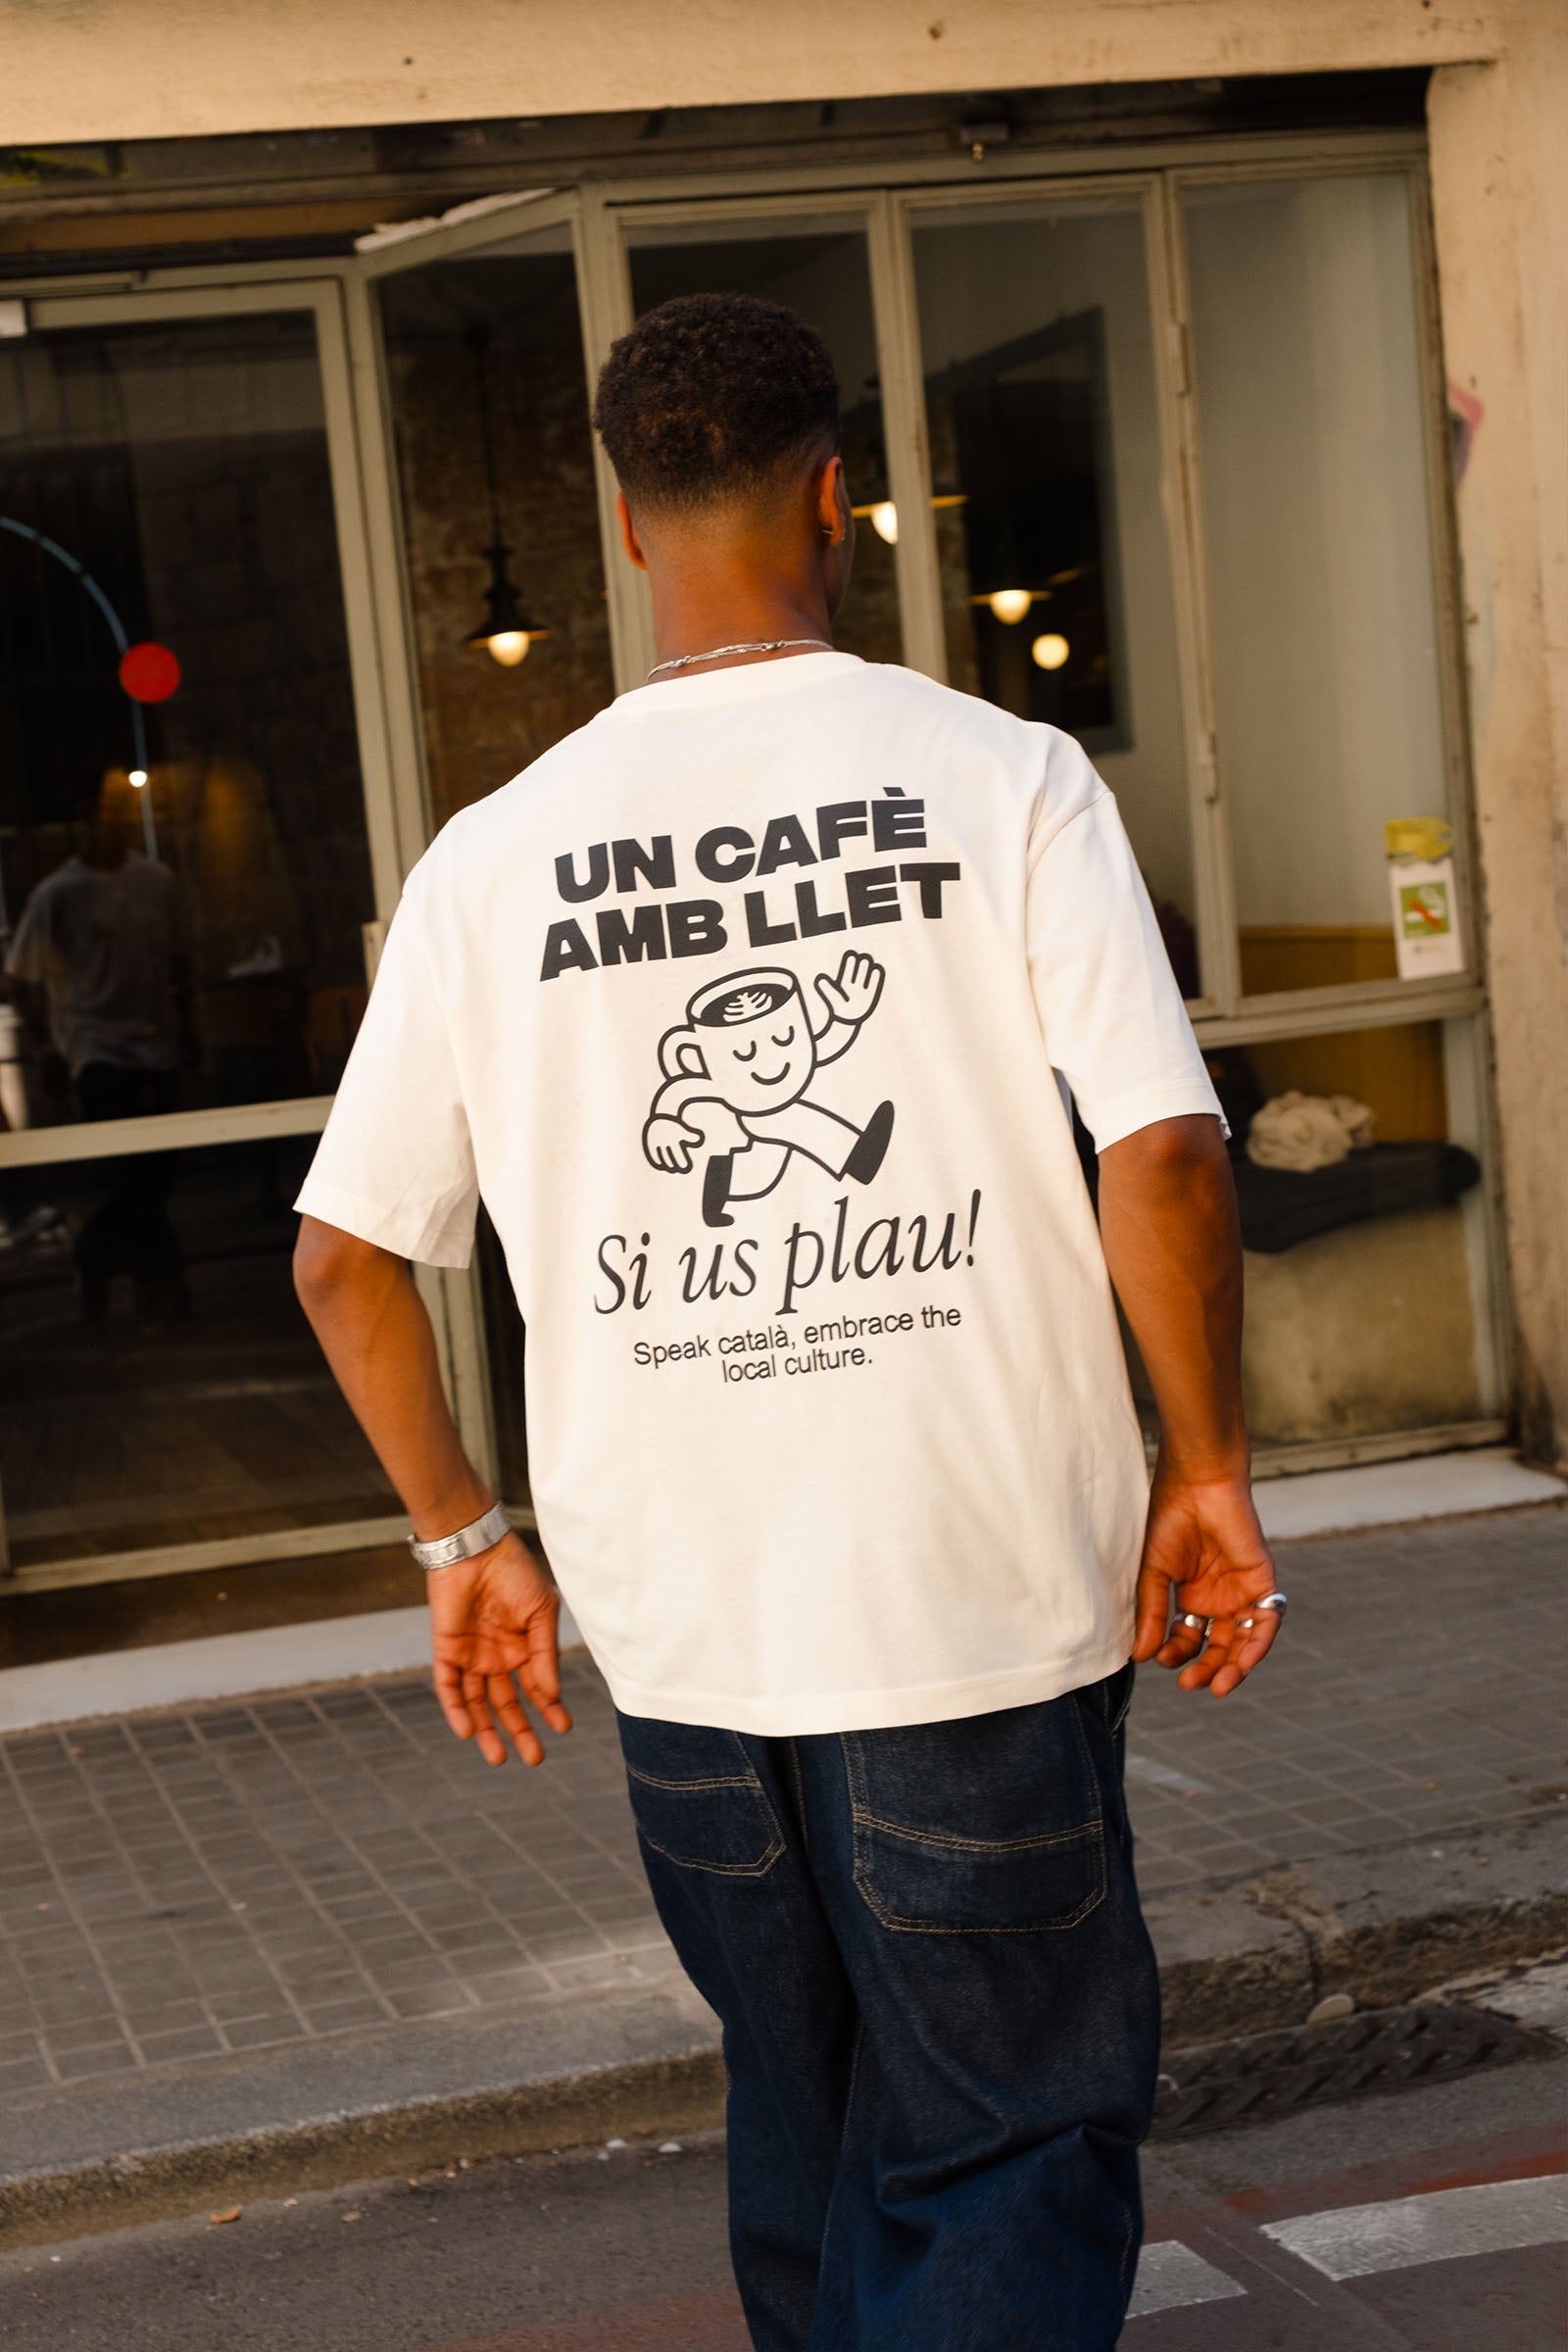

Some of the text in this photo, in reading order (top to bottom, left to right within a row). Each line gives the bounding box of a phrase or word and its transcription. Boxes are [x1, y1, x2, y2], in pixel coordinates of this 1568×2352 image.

[555, 787, 927, 904] UN CAFÈ
[539, 862, 960, 982] AMB LLET
[594, 1189, 981, 1316] Si us plau!
[633, 1304, 961, 1369] Speak català, embrace the
[721, 1345, 873, 1384] local culture.
